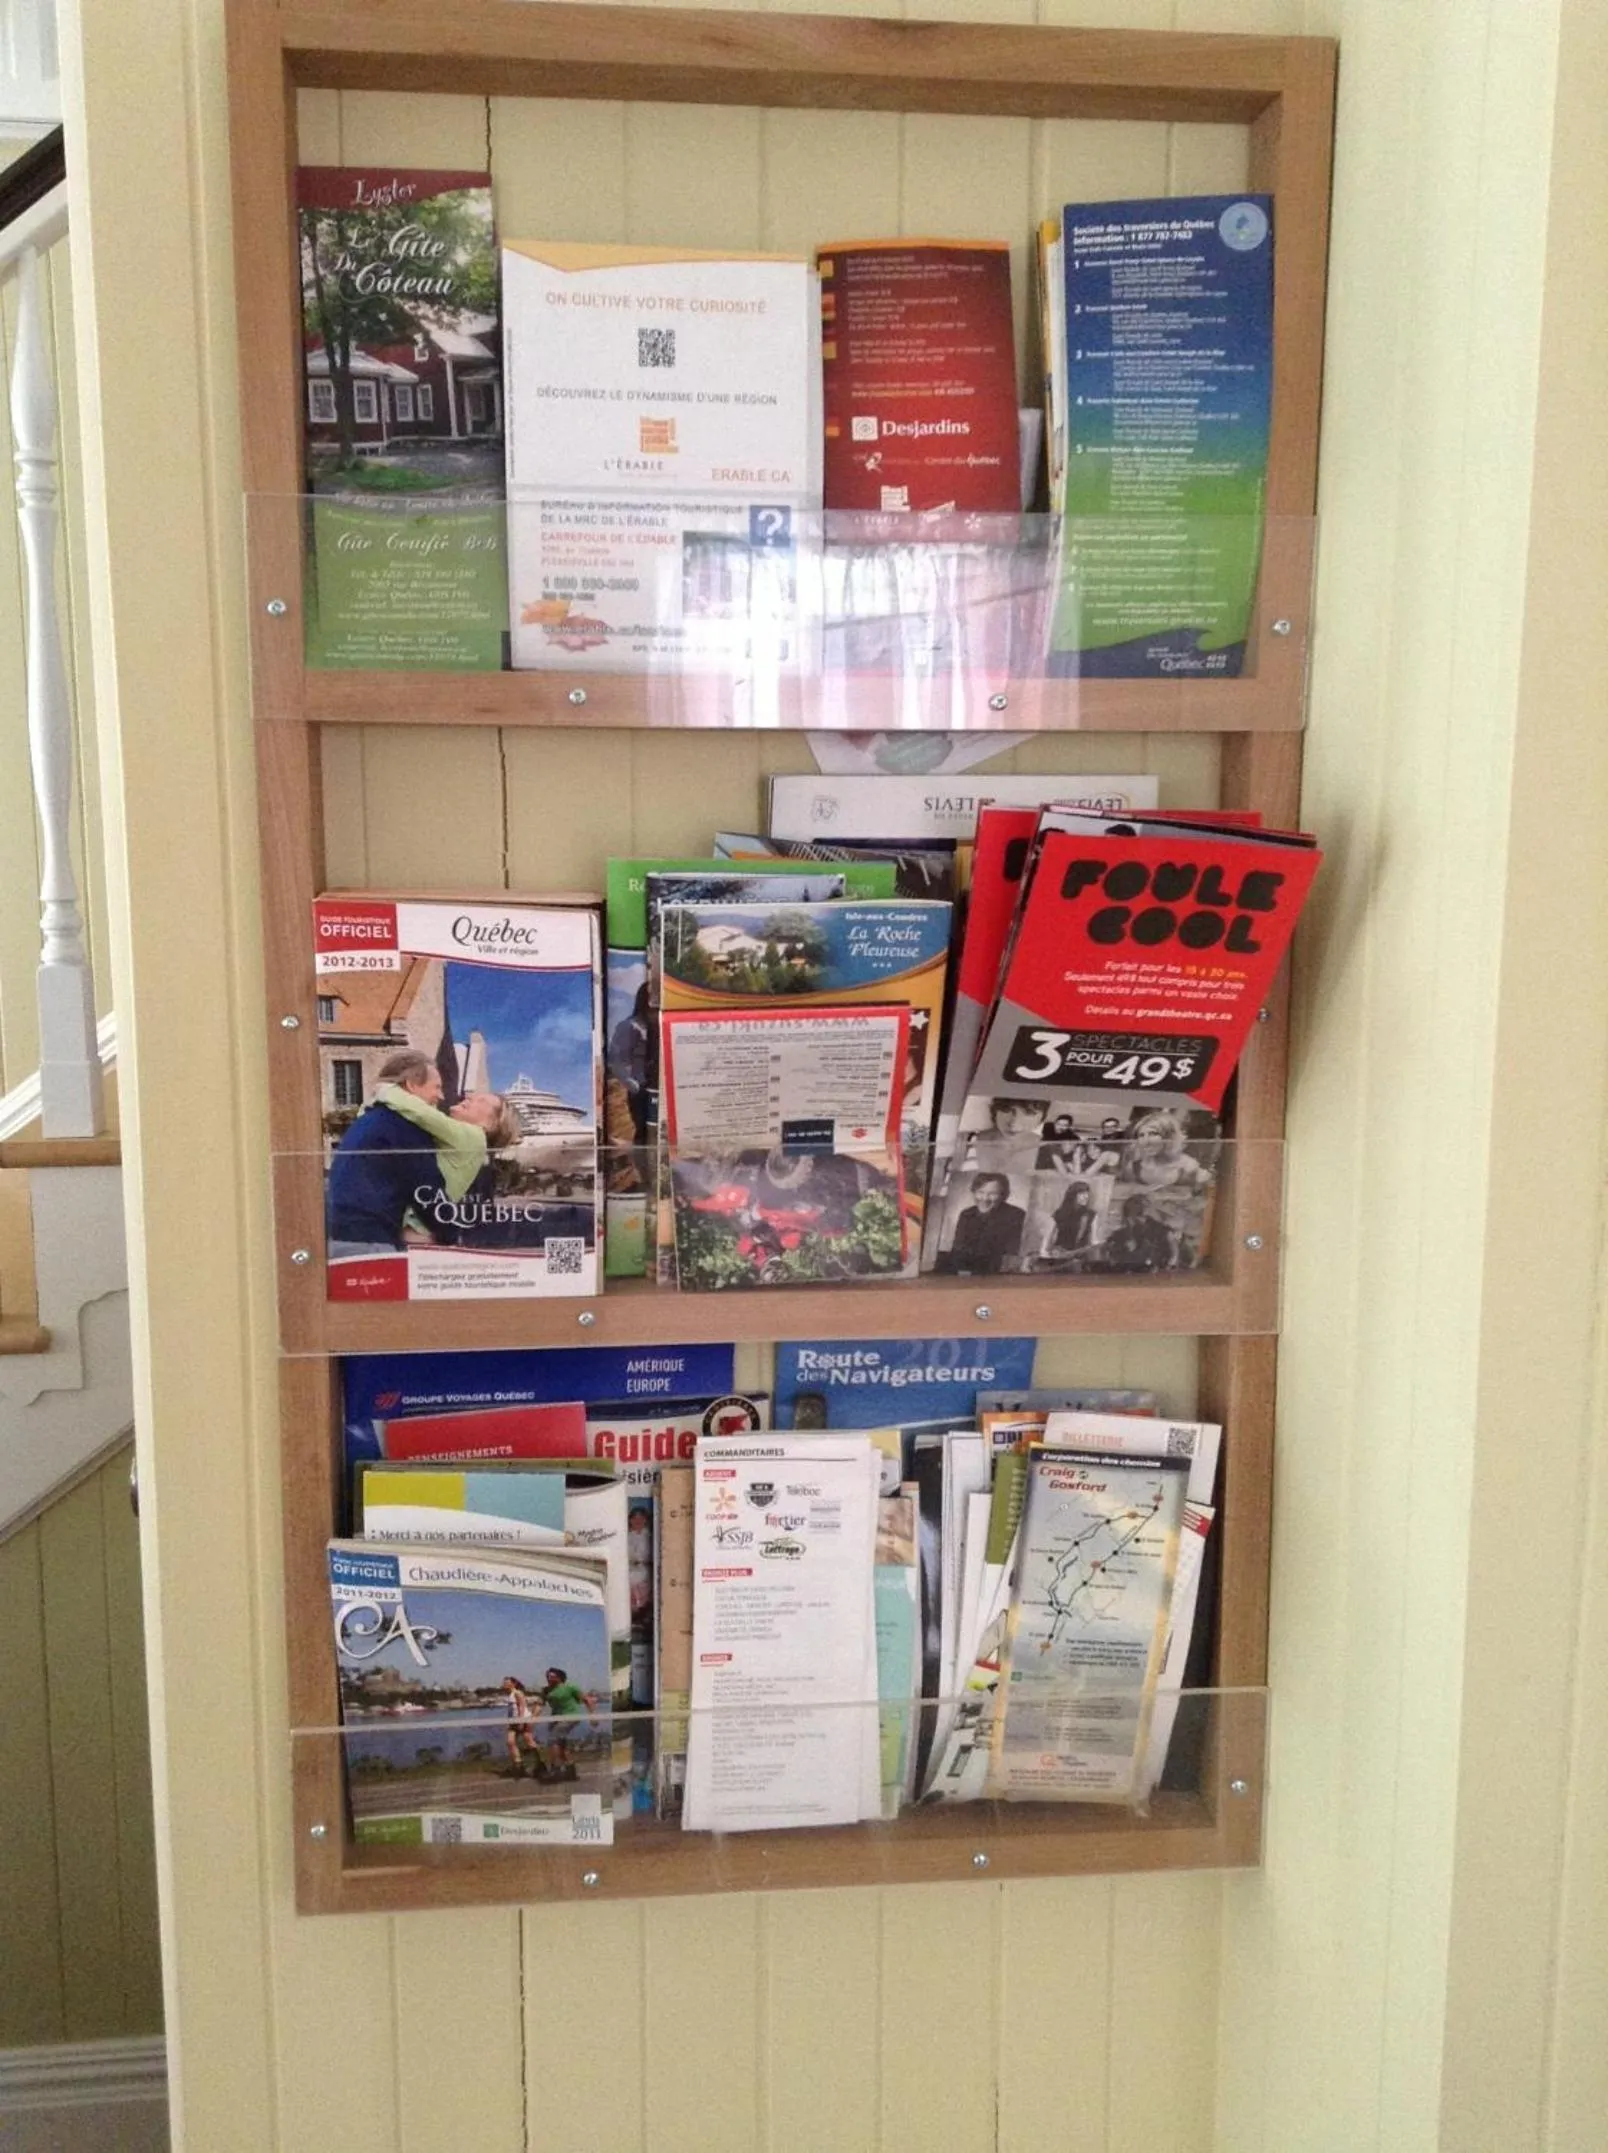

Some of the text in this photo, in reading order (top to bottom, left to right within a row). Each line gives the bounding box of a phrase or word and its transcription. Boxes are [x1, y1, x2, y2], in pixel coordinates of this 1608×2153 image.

[353, 179, 417, 207] Lyster
[1170, 221, 1181, 229] du
[1183, 219, 1215, 230] Québec
[388, 224, 445, 261] Gîte
[1073, 235, 1124, 245] Information
[356, 261, 454, 295] Côteau
[546, 291, 767, 314] ON CULTIVE VOTRE CURIOSITÉ
[537, 386, 606, 400] DÉCOUVREZ
[610, 390, 624, 400] LE
[627, 391, 692, 403] DYNAMISME
[734, 392, 777, 406] RÉGION
[882, 419, 970, 439] Desjardins
[604, 458, 664, 471] L'ÉRABLE
[540, 513, 553, 524] DE
[559, 514, 572, 525] LA
[574, 514, 598, 525] MRC
[601, 515, 615, 526] DE
[611, 533, 625, 544] DE
[1060, 858, 1285, 912] FOULE
[320, 923, 392, 939] OFFICIEL
[452, 915, 537, 947] Québec
[847, 924, 922, 944] La Roche
[1087, 905, 1262, 954] COOL
[322, 955, 393, 968] 2012-2013
[1104, 961, 1138, 972] Forfait
[1139, 964, 1165, 974] pour
[1166, 963, 1182, 975] les
[1064, 970, 1115, 982] Seulement
[1138, 973, 1157, 983] tout
[1158, 976, 1198, 988] compris
[1198, 979, 1223, 990] pour
[1224, 980, 1245, 990] trois
[1077, 984, 1131, 995] spectacles
[1132, 987, 1162, 996] parmi
[1164, 989, 1178, 997] un
[1181, 990, 1208, 999] vaste
[1085, 1004, 1120, 1016] Détails
[1122, 1007, 1134, 1016] au
[1015, 1030, 1202, 1080] 3 SPECTACLES
[1065, 1051, 1197, 1087] POUR 49$
[414, 1185, 447, 1209] ÇA
[434, 1198, 544, 1229] QUÉBEC
[626, 1358, 686, 1374] AMÉRIQUE
[797, 1350, 880, 1370] Route
[829, 1364, 996, 1388] Navigateurs
[626, 1377, 671, 1394] EUROPE
[402, 1391, 536, 1404] GROUPE VOYAGES QUÉBEC
[594, 1427, 697, 1464] Guide
[703, 1447, 785, 1458] COMMANDITAIRES
[1042, 1452, 1161, 1468] Corporation des chemins
[1039, 1466, 1076, 1480] Craig
[1048, 1479, 1108, 1493] Gosford
[379, 1528, 410, 1541] Merci
[413, 1529, 423, 1541] à
[426, 1532, 446, 1541] nos
[449, 1529, 513, 1543] partenaires
[333, 1563, 396, 1579] OFFICIEL
[336, 1587, 396, 1600] 2011-2012
